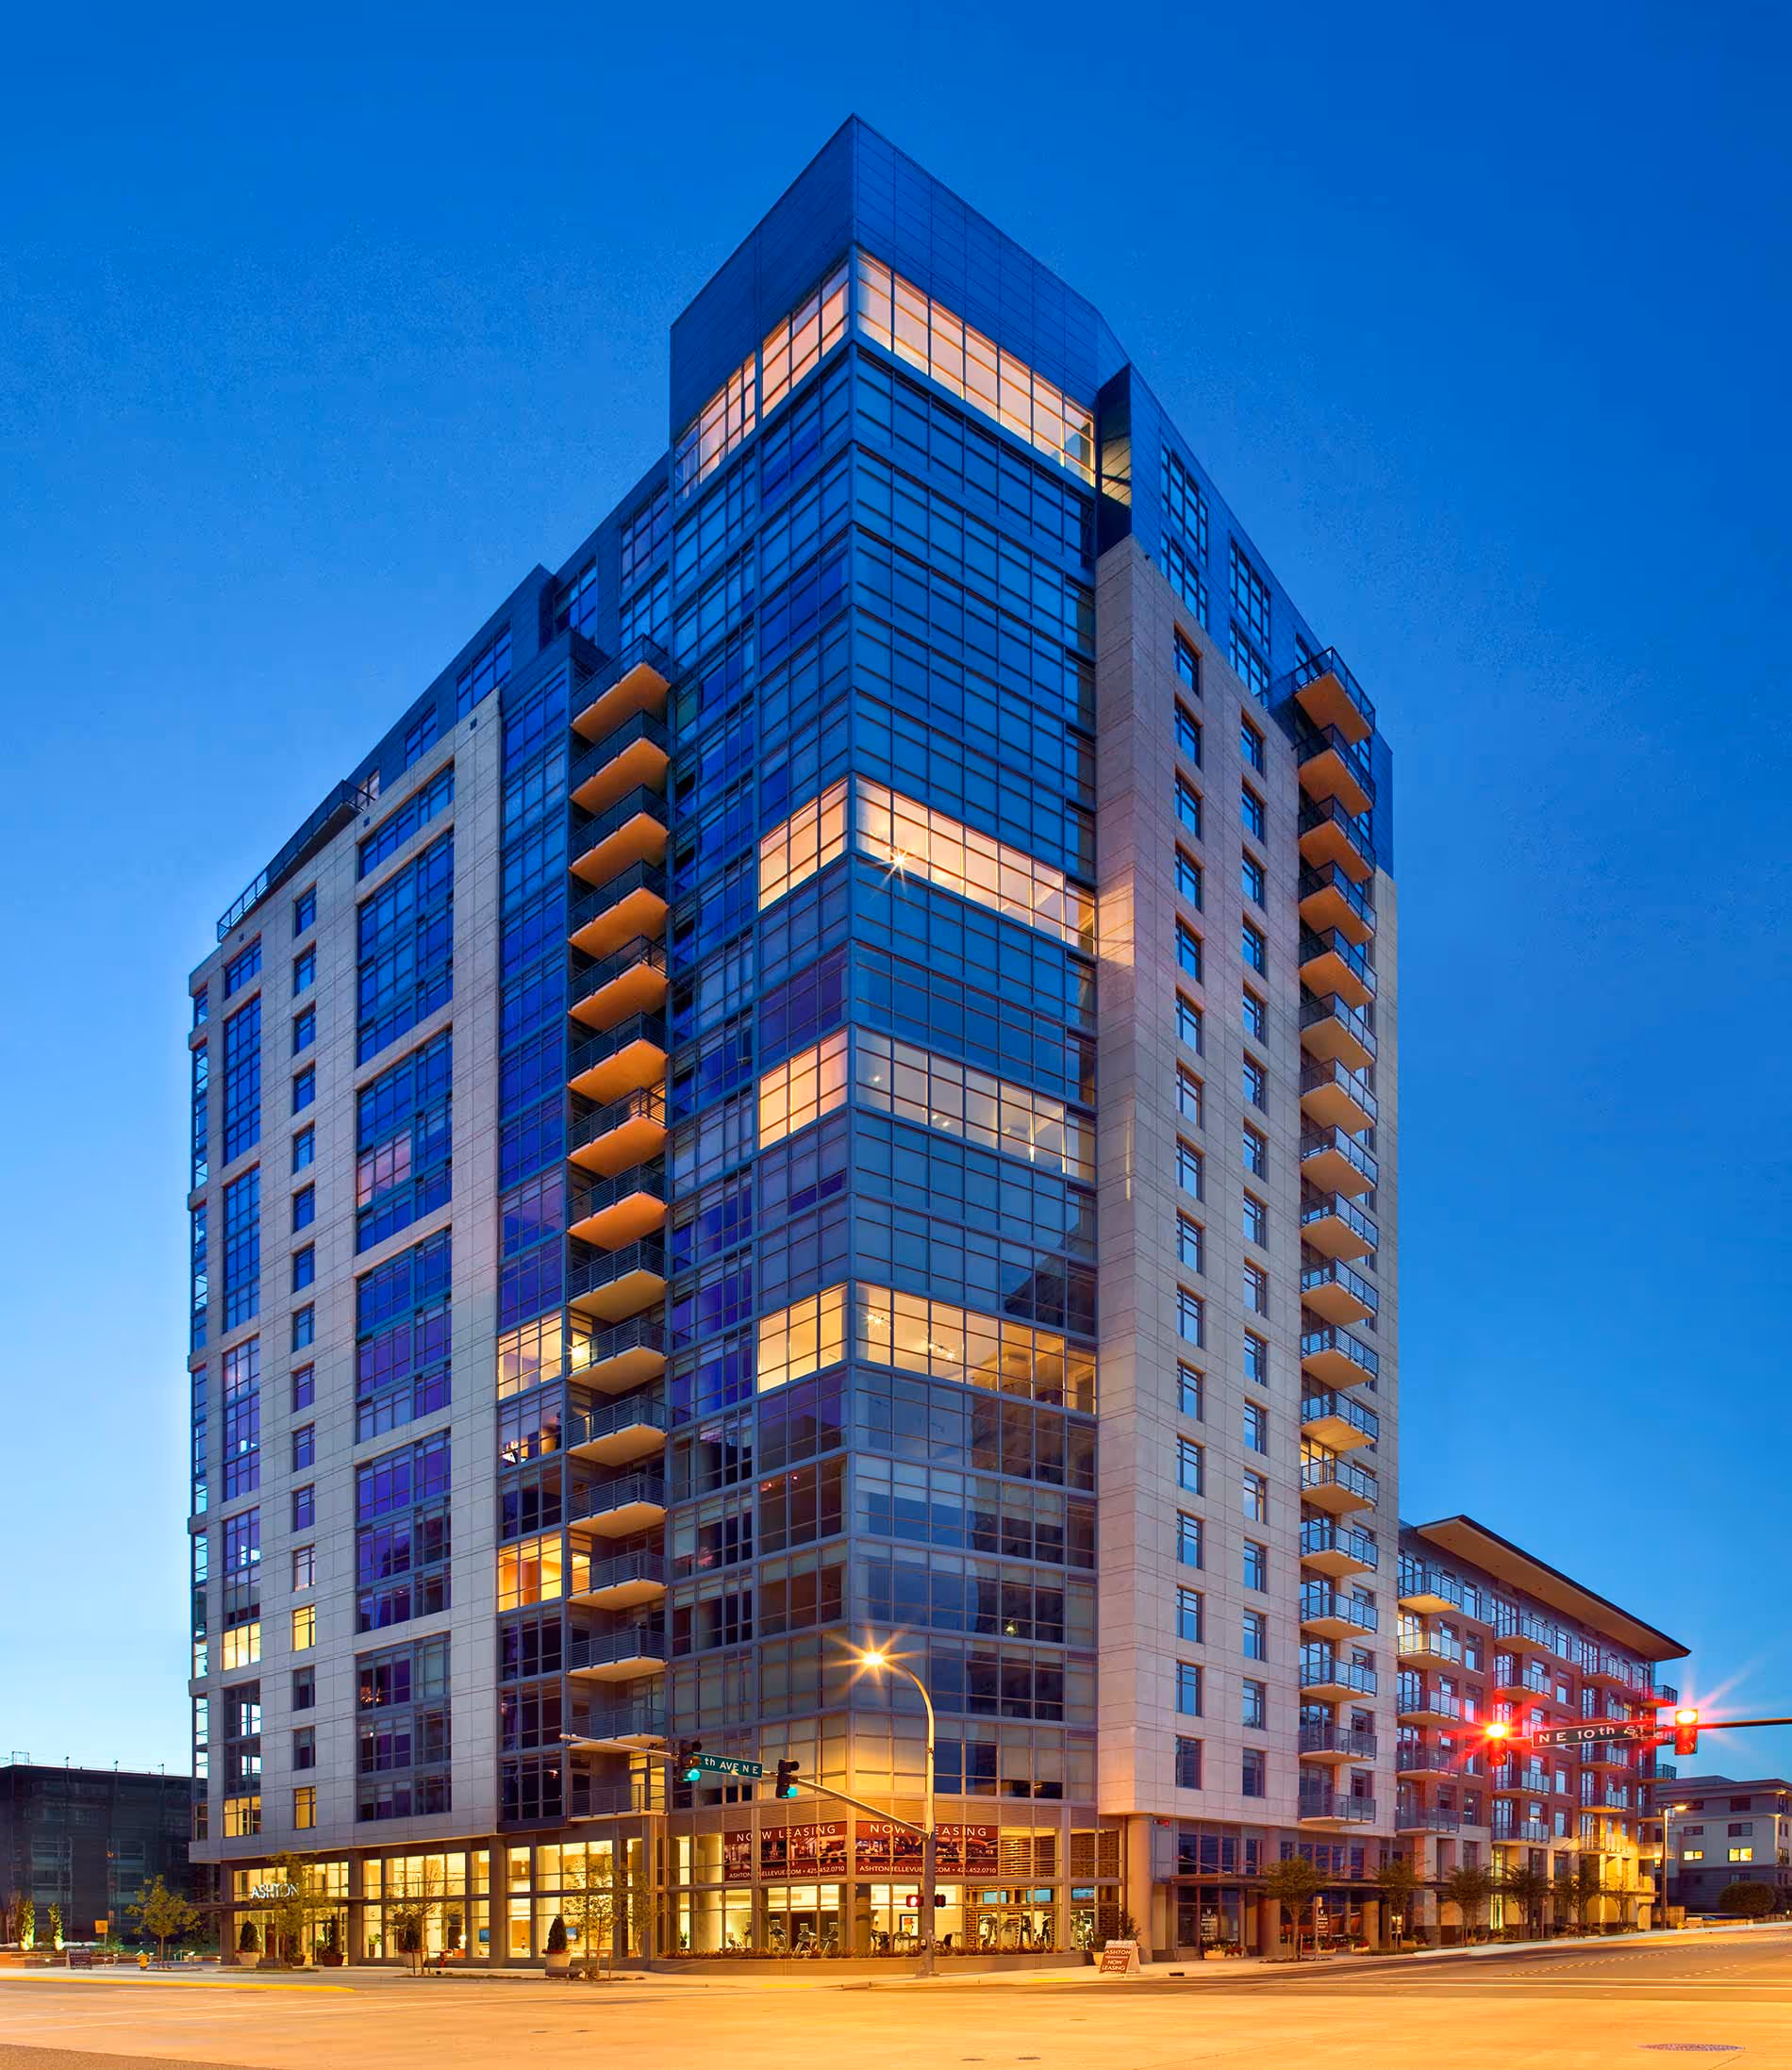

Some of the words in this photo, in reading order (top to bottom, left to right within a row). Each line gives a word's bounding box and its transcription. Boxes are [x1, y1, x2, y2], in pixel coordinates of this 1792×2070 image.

[1576, 1725, 1616, 1740] 10th
[701, 1757, 716, 1766] th
[720, 1762, 739, 1772] AVE
[737, 1830, 772, 1843] NOW
[778, 1825, 836, 1839] LEASING
[870, 1824, 905, 1834] NOW
[935, 1826, 987, 1837] EASNG
[251, 1882, 299, 1899] ASHTON
